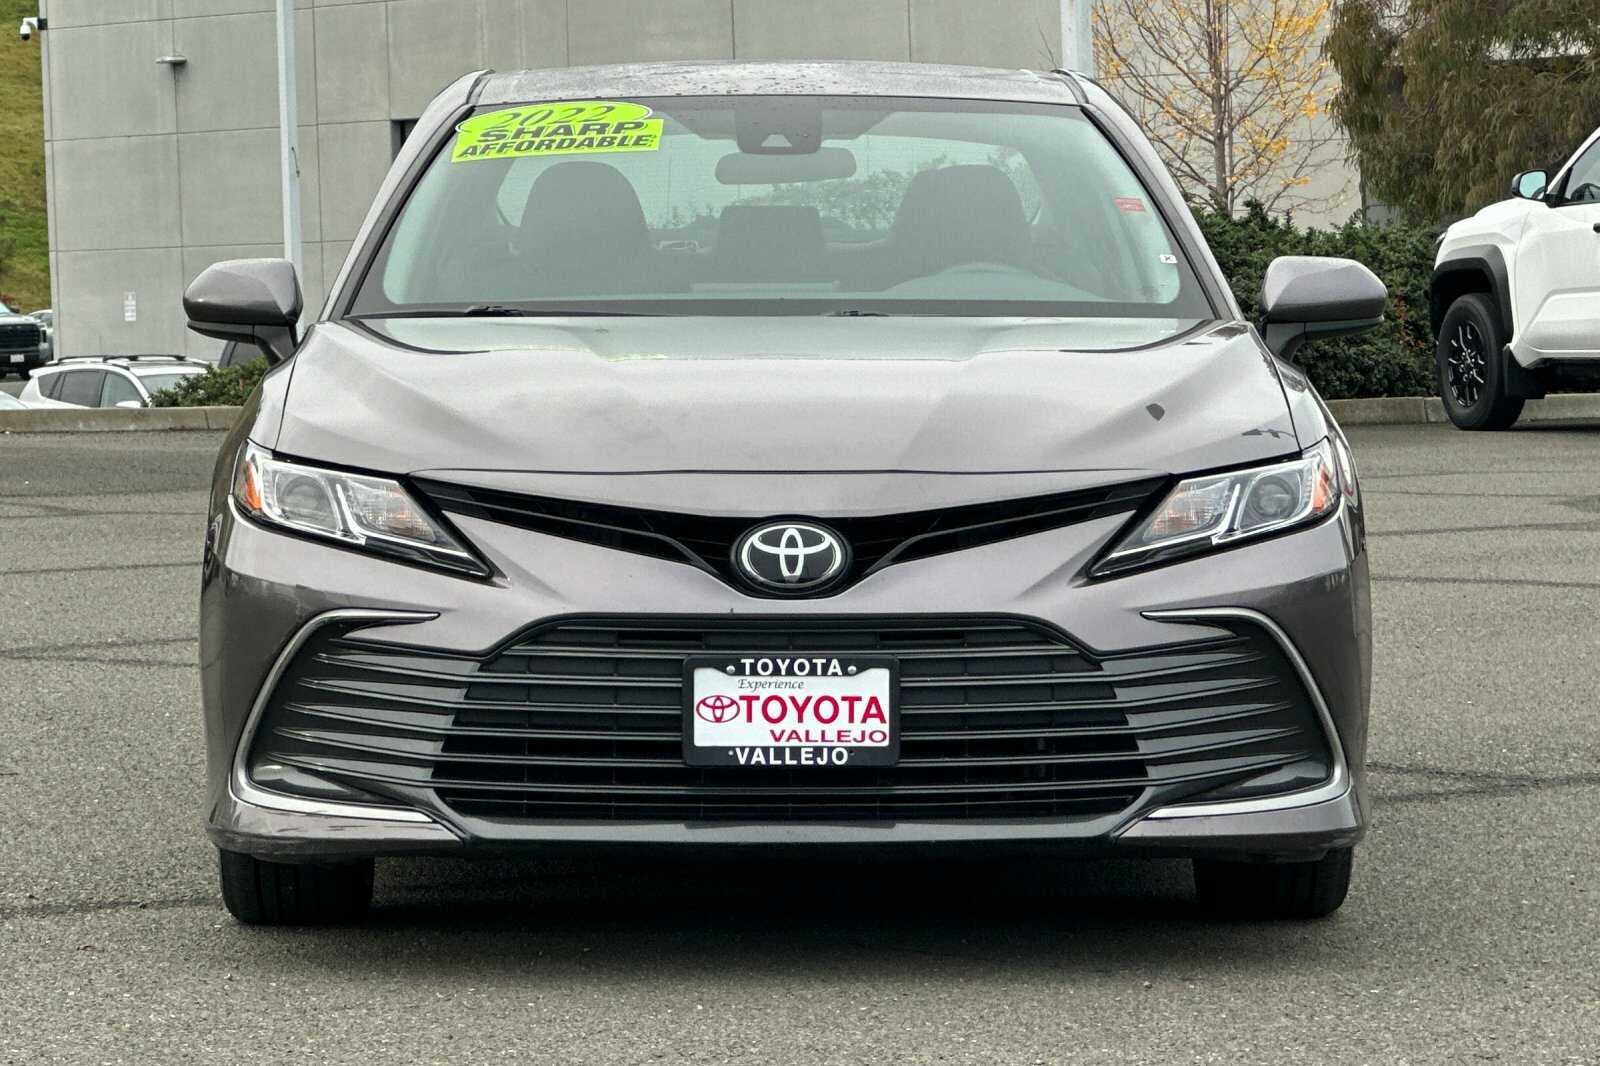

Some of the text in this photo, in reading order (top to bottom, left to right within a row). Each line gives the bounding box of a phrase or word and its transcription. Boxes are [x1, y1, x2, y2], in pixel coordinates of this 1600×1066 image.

[484, 105, 616, 129] 2022
[477, 121, 648, 143] SHARP
[456, 133, 658, 158] AFFORDABLE
[740, 658, 843, 676] TOYOTA
[737, 678, 805, 693] Experience
[739, 694, 887, 724] TOYOTA
[769, 729, 888, 744] VALLEJO
[735, 747, 849, 766] VALLEJO
